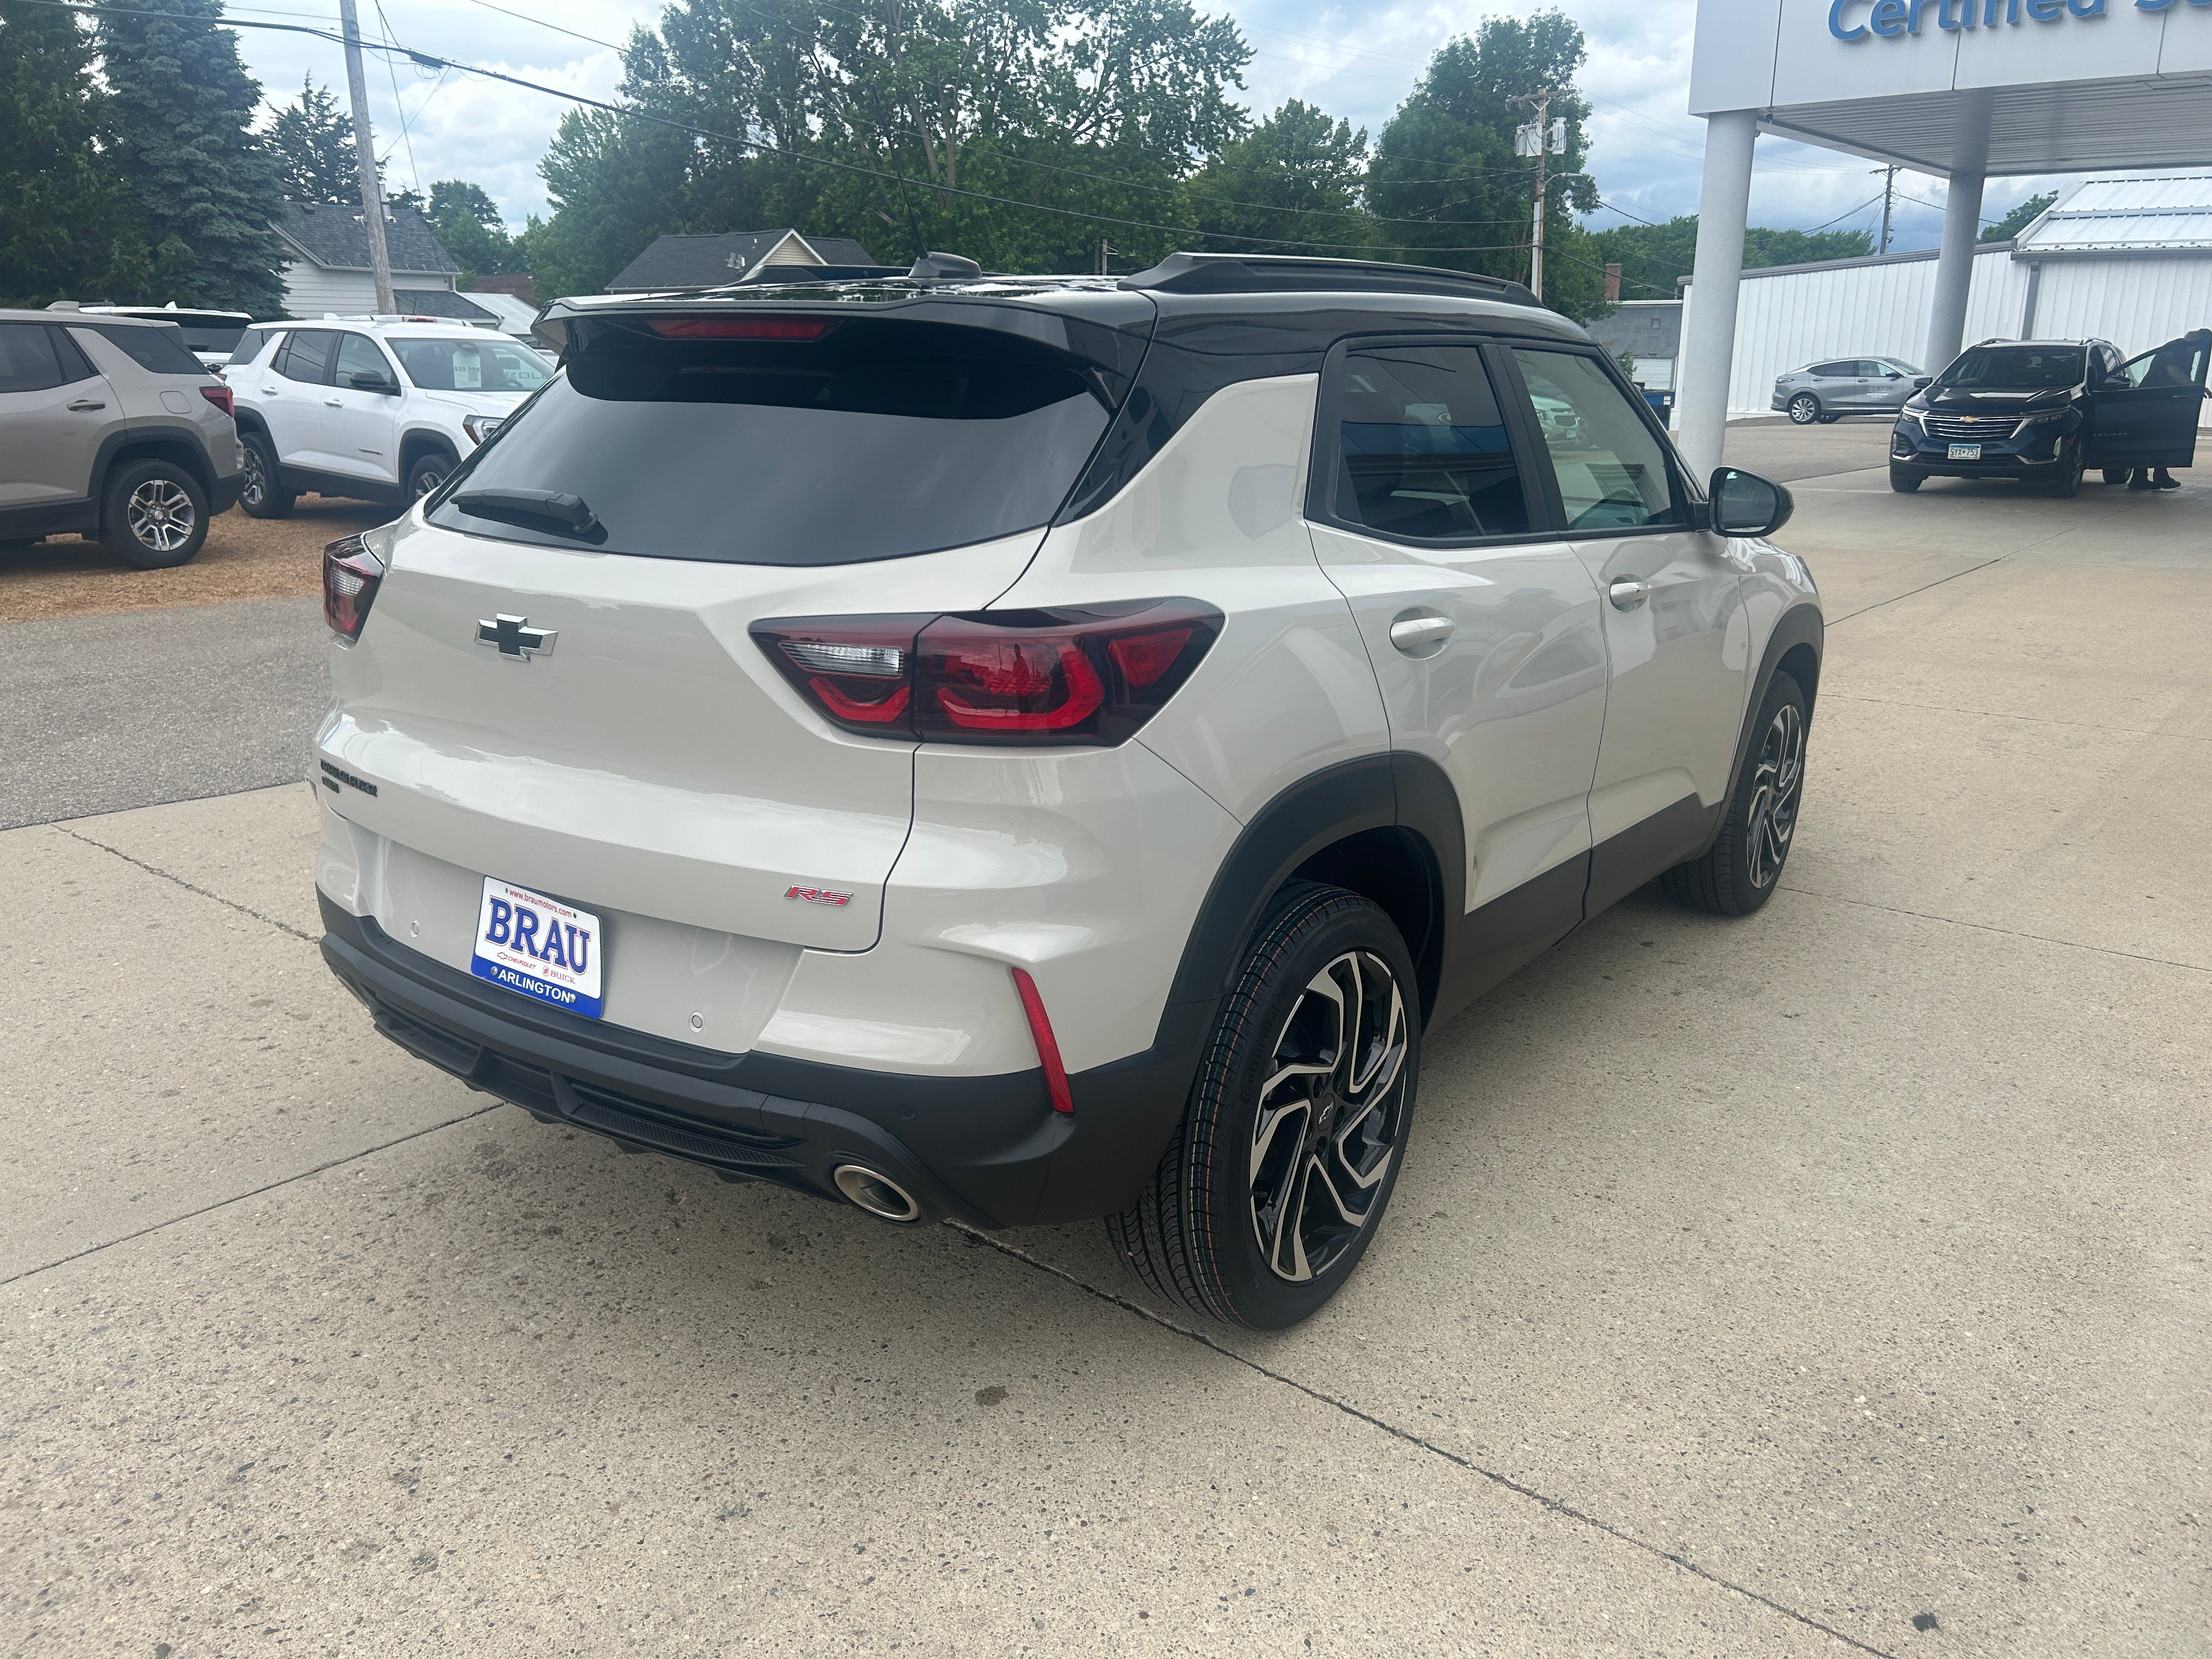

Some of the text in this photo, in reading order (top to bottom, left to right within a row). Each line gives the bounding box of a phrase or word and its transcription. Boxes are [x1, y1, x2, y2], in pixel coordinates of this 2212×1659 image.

[1967, 448, 1979, 456] 753
[509, 889, 572, 918] www.braumotors.com
[783, 884, 854, 906] RS
[484, 895, 591, 975] BRAU
[508, 956, 576, 985] CHEVROLET BUICK
[498, 969, 571, 1003] ARLINGTON
